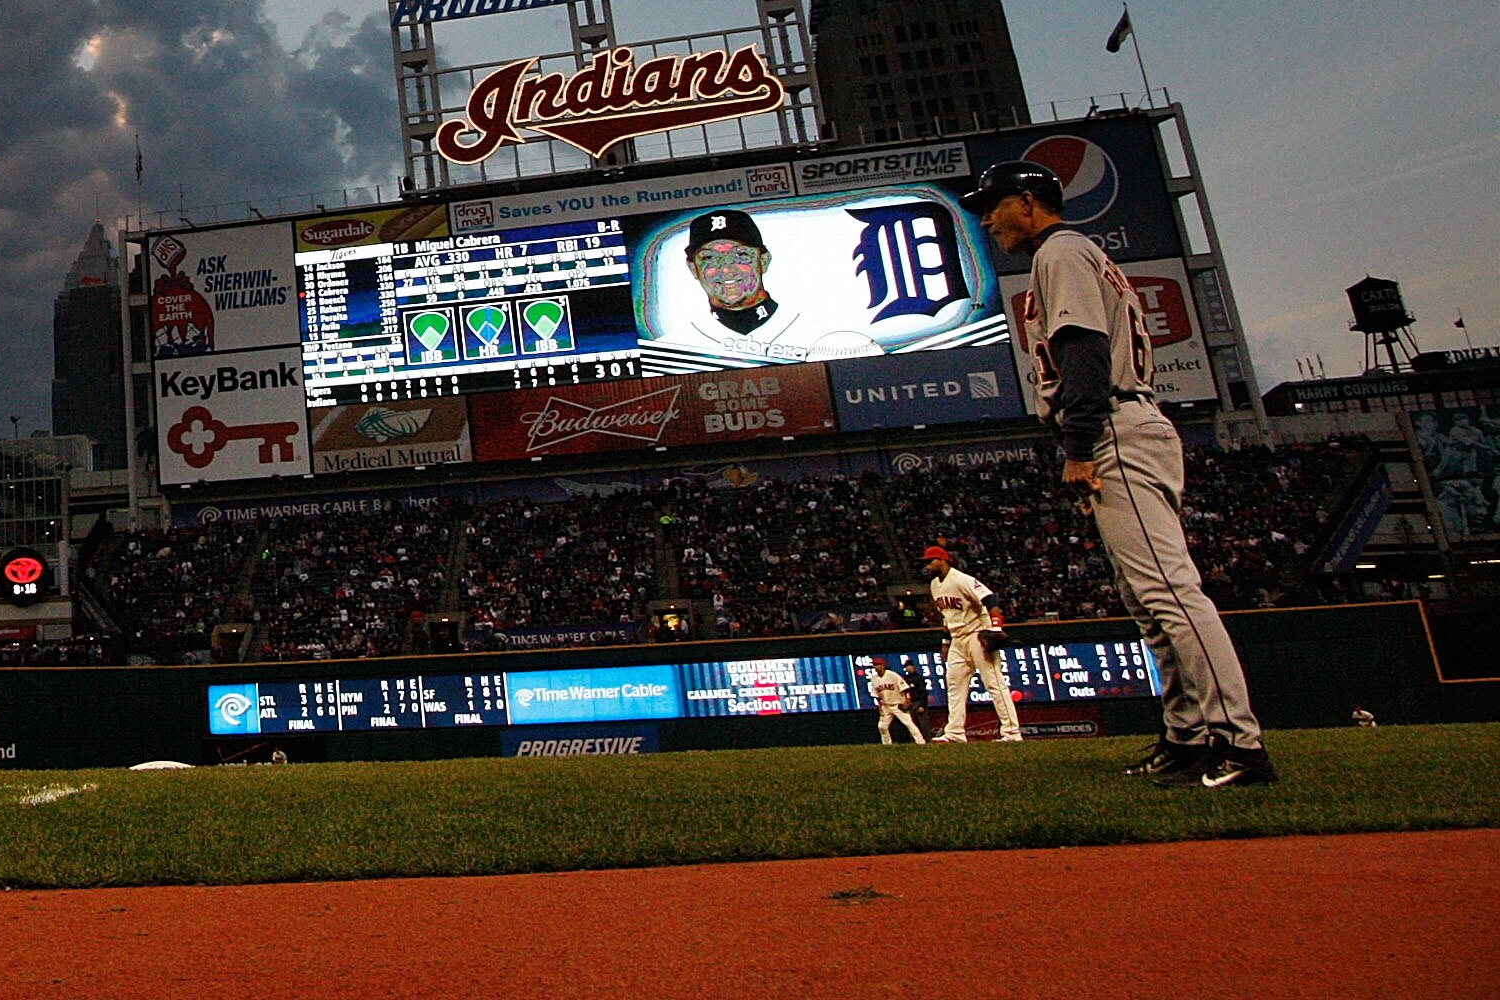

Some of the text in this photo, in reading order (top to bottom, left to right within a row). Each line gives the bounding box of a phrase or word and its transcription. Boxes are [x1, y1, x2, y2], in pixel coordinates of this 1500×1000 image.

[437, 42, 786, 163] Indians
[801, 147, 964, 180] SPORTSTIME
[913, 163, 956, 177] OHIO
[749, 168, 781, 186] drug
[753, 180, 790, 194] mart
[499, 177, 743, 220] Saves YOU the Runaround!
[458, 203, 487, 221] drug
[461, 216, 492, 229] mart
[302, 219, 375, 244] Sugardale
[394, 220, 621, 255] 1B Miguel Cabrera B-R
[415, 237, 600, 268] AVG .330 HR 7 RBI 19
[197, 255, 227, 276] ASK
[204, 269, 278, 293] SHERWIN-
[157, 294, 192, 305] COVER
[215, 286, 287, 311] WILLIAMS
[164, 303, 186, 313] THE
[159, 311, 192, 322] EARTH
[479, 346, 499, 358] HR
[595, 361, 635, 378] 3 0 1
[160, 361, 299, 402] KeyBank
[305, 387, 332, 398] Tigers
[699, 377, 781, 402] GRAB
[845, 380, 962, 404] UNITED
[713, 396, 770, 413] SOME
[520, 405, 681, 438] Budweiser
[703, 408, 785, 434] BUDS
[323, 443, 463, 472] Medical Mutual
[1015, 647, 1040, 660] H E
[1048, 642, 1139, 657] 4th R H E
[918, 652, 943, 665] H E
[1019, 660, 1027, 672] 2
[1058, 654, 1142, 670] BAL 2 3 0
[726, 659, 797, 674] GOURMET
[464, 675, 501, 687] R H E
[731, 671, 797, 687] POPCORN
[1022, 673, 1046, 686] 5 2
[1061, 668, 1145, 684] CHW 0 4 0
[299, 682, 334, 694] R H E
[381, 679, 417, 690] R H E
[924, 679, 933, 690] 2
[1067, 686, 1096, 698] Outs
[259, 693, 335, 706] STL 3 6 0
[340, 690, 417, 703] NYM 1 7 0
[423, 689, 436, 700] SF
[466, 687, 474, 698] 2
[495, 686, 501, 697] 1
[533, 687, 568, 703] Time
[567, 685, 621, 700] Warner
[260, 705, 336, 719] ATL 2 6 0
[341, 702, 418, 715] PHI 2 7 0
[424, 698, 504, 712] WAS 1 2 0
[727, 696, 809, 713] Section 175
[288, 719, 315, 730] FINAL
[370, 716, 398, 727] FINAL
[454, 713, 483, 724] FINAL
[517, 737, 643, 757] PROGRESSIVE
